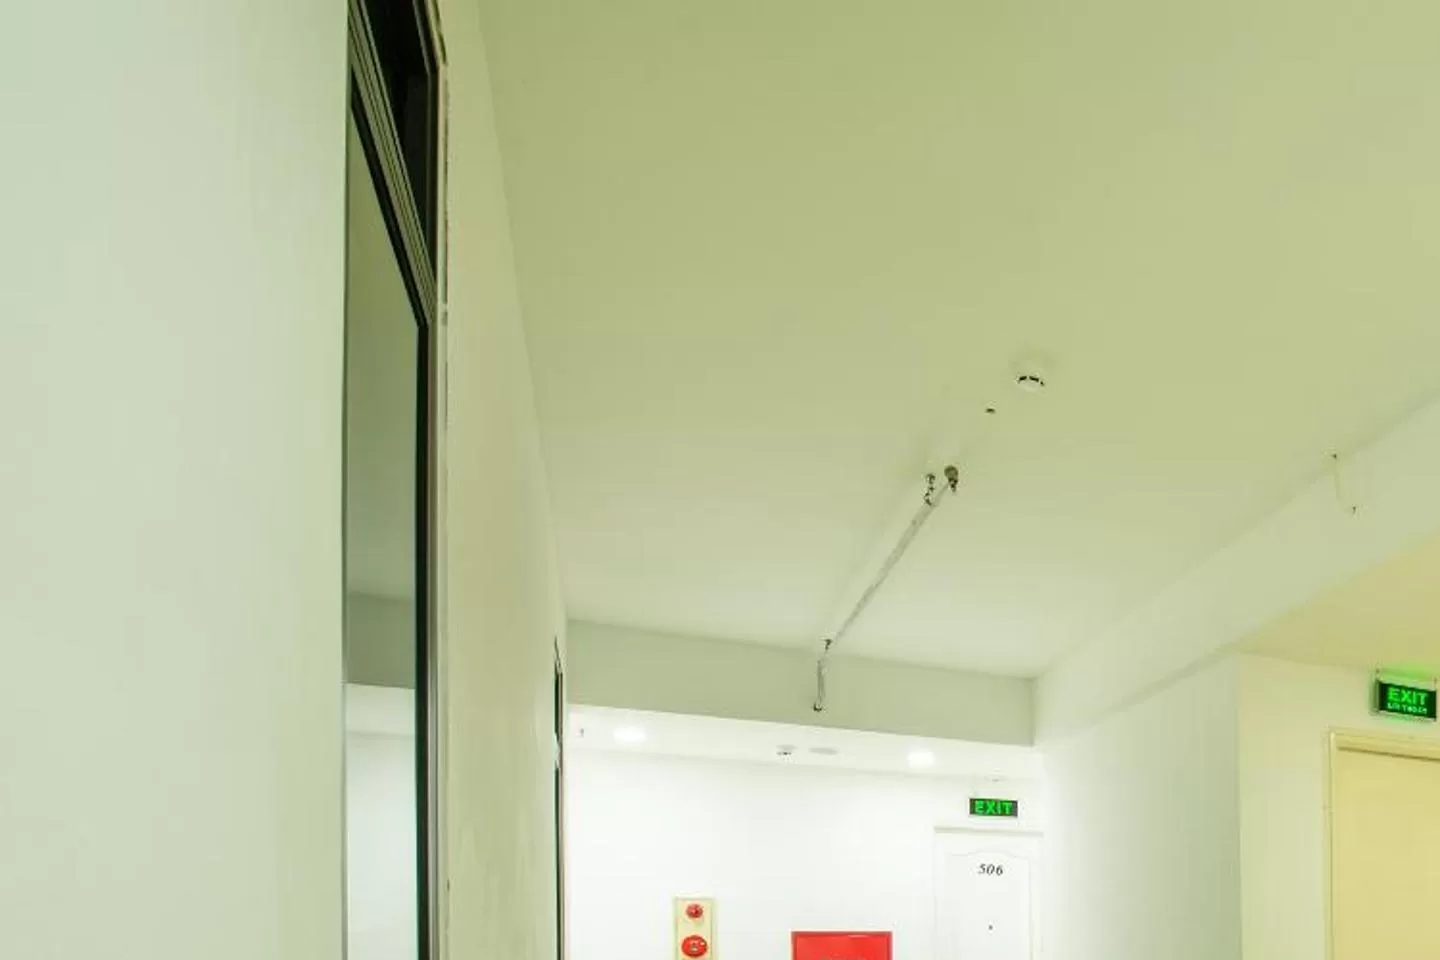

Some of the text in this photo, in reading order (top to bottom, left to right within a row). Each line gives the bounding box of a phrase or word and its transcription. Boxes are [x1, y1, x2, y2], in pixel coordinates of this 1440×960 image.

[1388, 687, 1428, 705] EXIT
[975, 800, 1012, 815] EXIT
[978, 863, 1003, 876] 506
